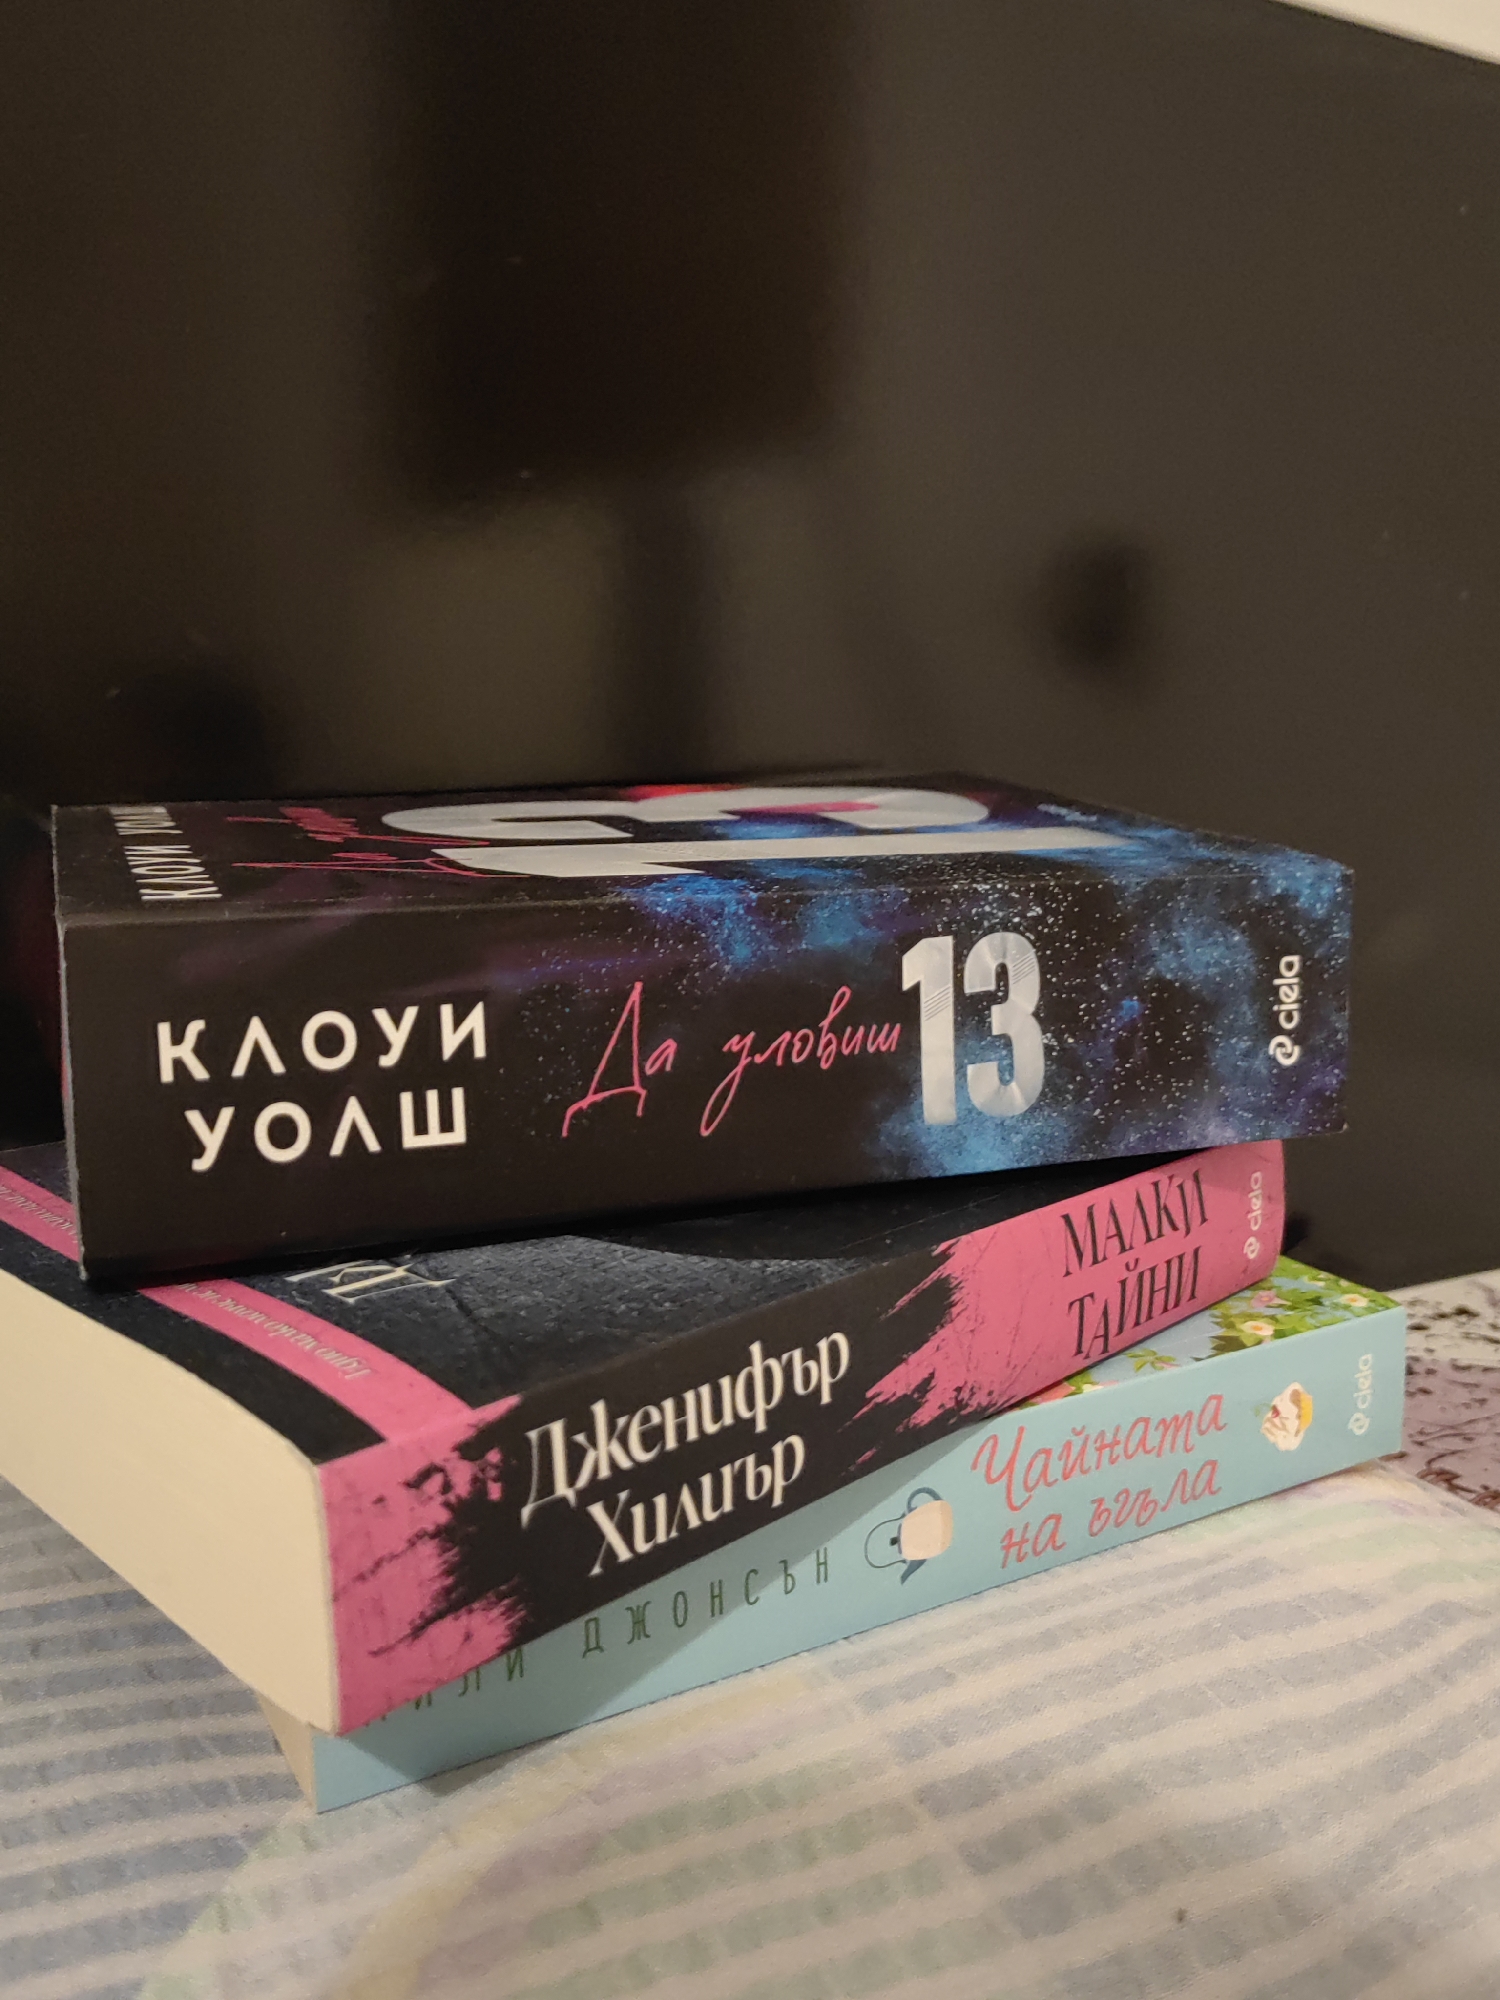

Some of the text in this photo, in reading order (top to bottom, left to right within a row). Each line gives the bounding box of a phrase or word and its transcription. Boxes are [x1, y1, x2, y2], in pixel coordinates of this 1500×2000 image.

[124, 844, 223, 900] КЛОУИ
[157, 1000, 487, 1084] КЛОУИ
[561, 931, 1046, 1138] Да уловиш 13
[1271, 954, 1301, 1030] ciela
[184, 1086, 467, 1173] УОЛШ
[1060, 1168, 1209, 1279] МАЛКИ
[1247, 1171, 1263, 1231] ciela
[1067, 1245, 1203, 1361] ТАЙНИ
[519, 1331, 851, 1530] Дженифър
[1353, 1353, 1374, 1411] ciela
[587, 1434, 807, 1578] Хилиър
[970, 1393, 1228, 1513] Чайната
[1000, 1458, 1222, 1570] на ъгъла
[581, 1546, 830, 1659] ДЖОНСЪН
